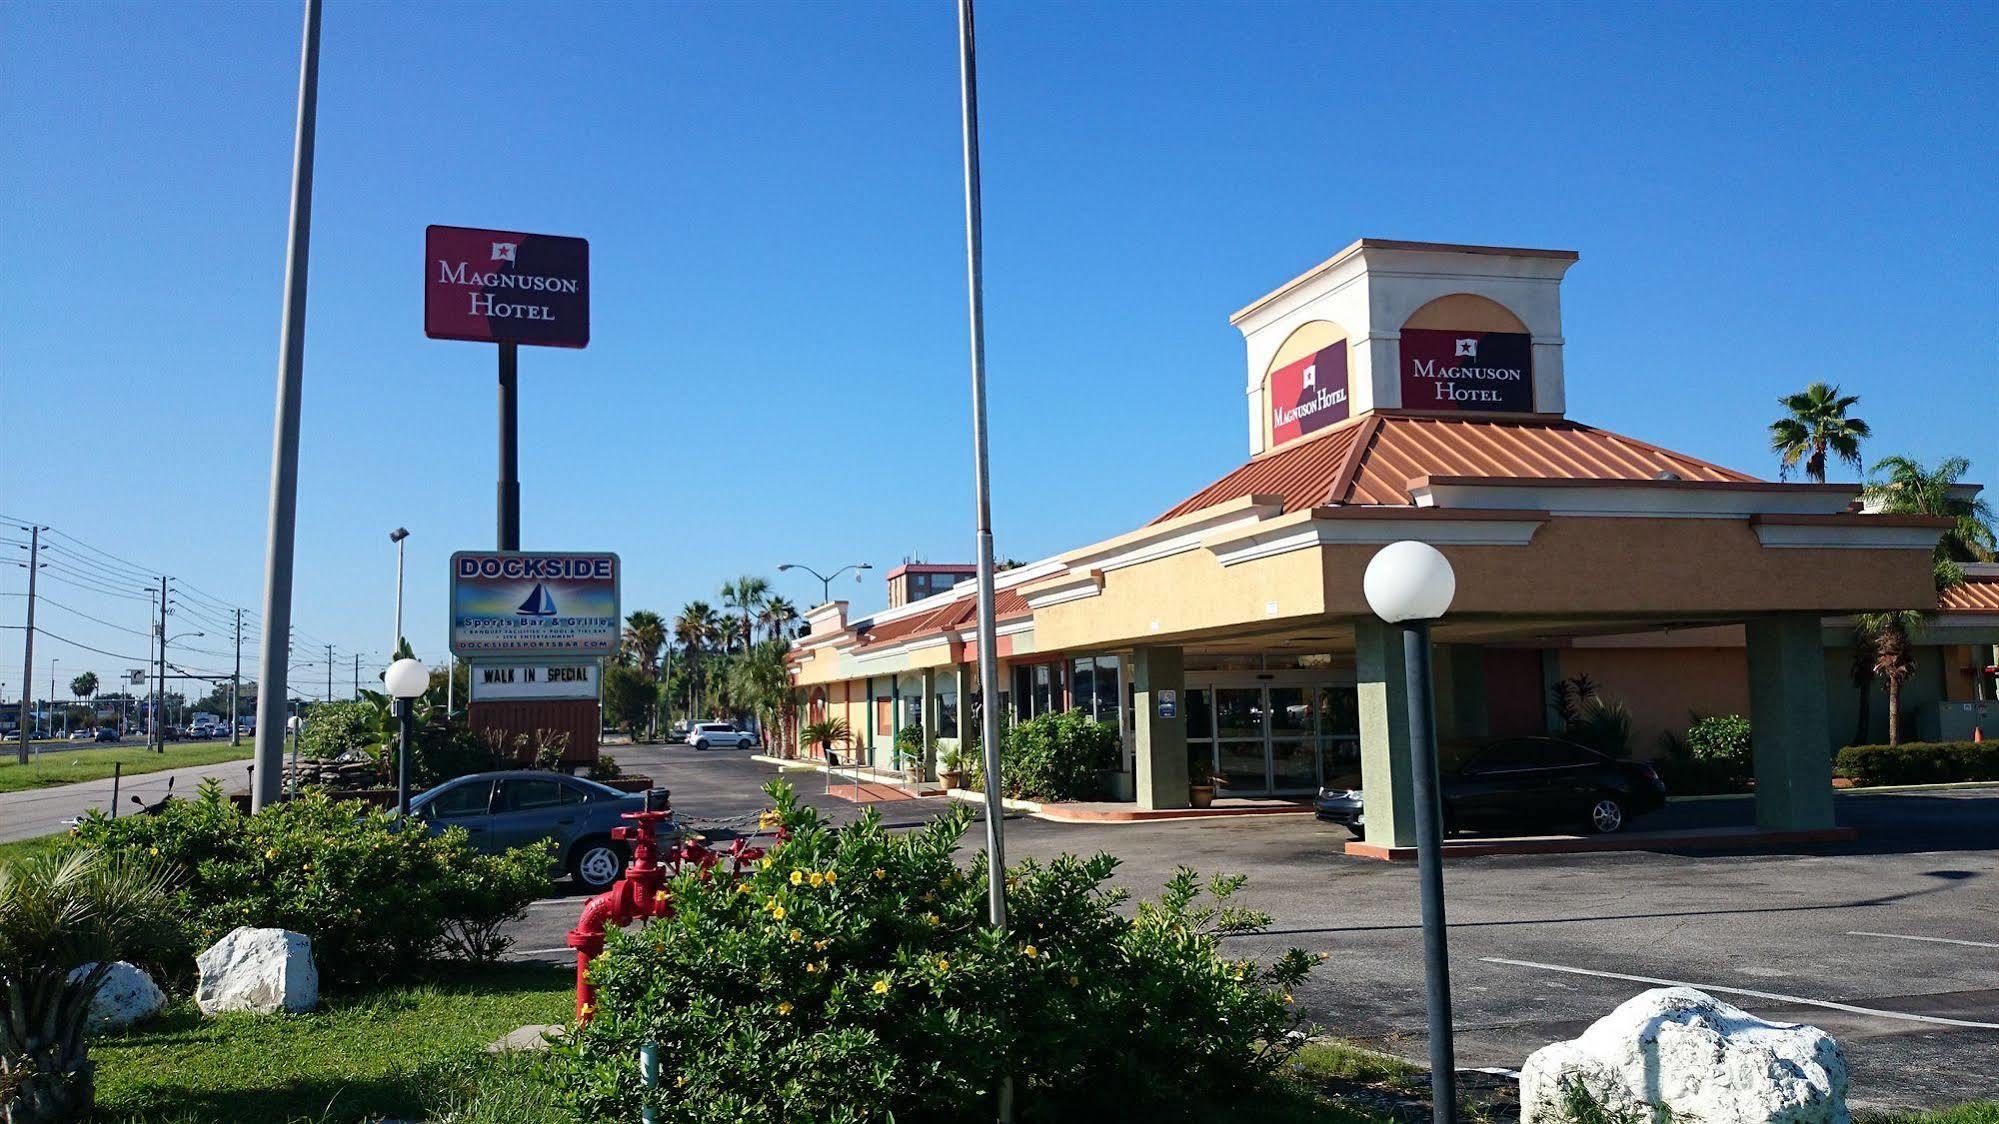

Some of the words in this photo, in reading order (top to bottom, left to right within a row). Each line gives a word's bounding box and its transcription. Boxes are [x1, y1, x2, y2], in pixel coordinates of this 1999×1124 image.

[439, 260, 577, 293] MAGNUSON
[468, 292, 555, 320] HOTEL
[1413, 359, 1520, 381] MAGNUSON
[1434, 381, 1502, 402] HOTEL
[1274, 399, 1317, 428] MAGNUSON
[1317, 387, 1347, 411] HOTEL
[460, 558, 612, 579] DOCKSIDE
[464, 617, 513, 628] Sports
[520, 617, 544, 626] Bar
[551, 617, 559, 626] &
[567, 617, 607, 626] Grille
[484, 668, 515, 683] WALK
[524, 668, 536, 682] IN
[547, 667, 588, 682] SPECIAL
